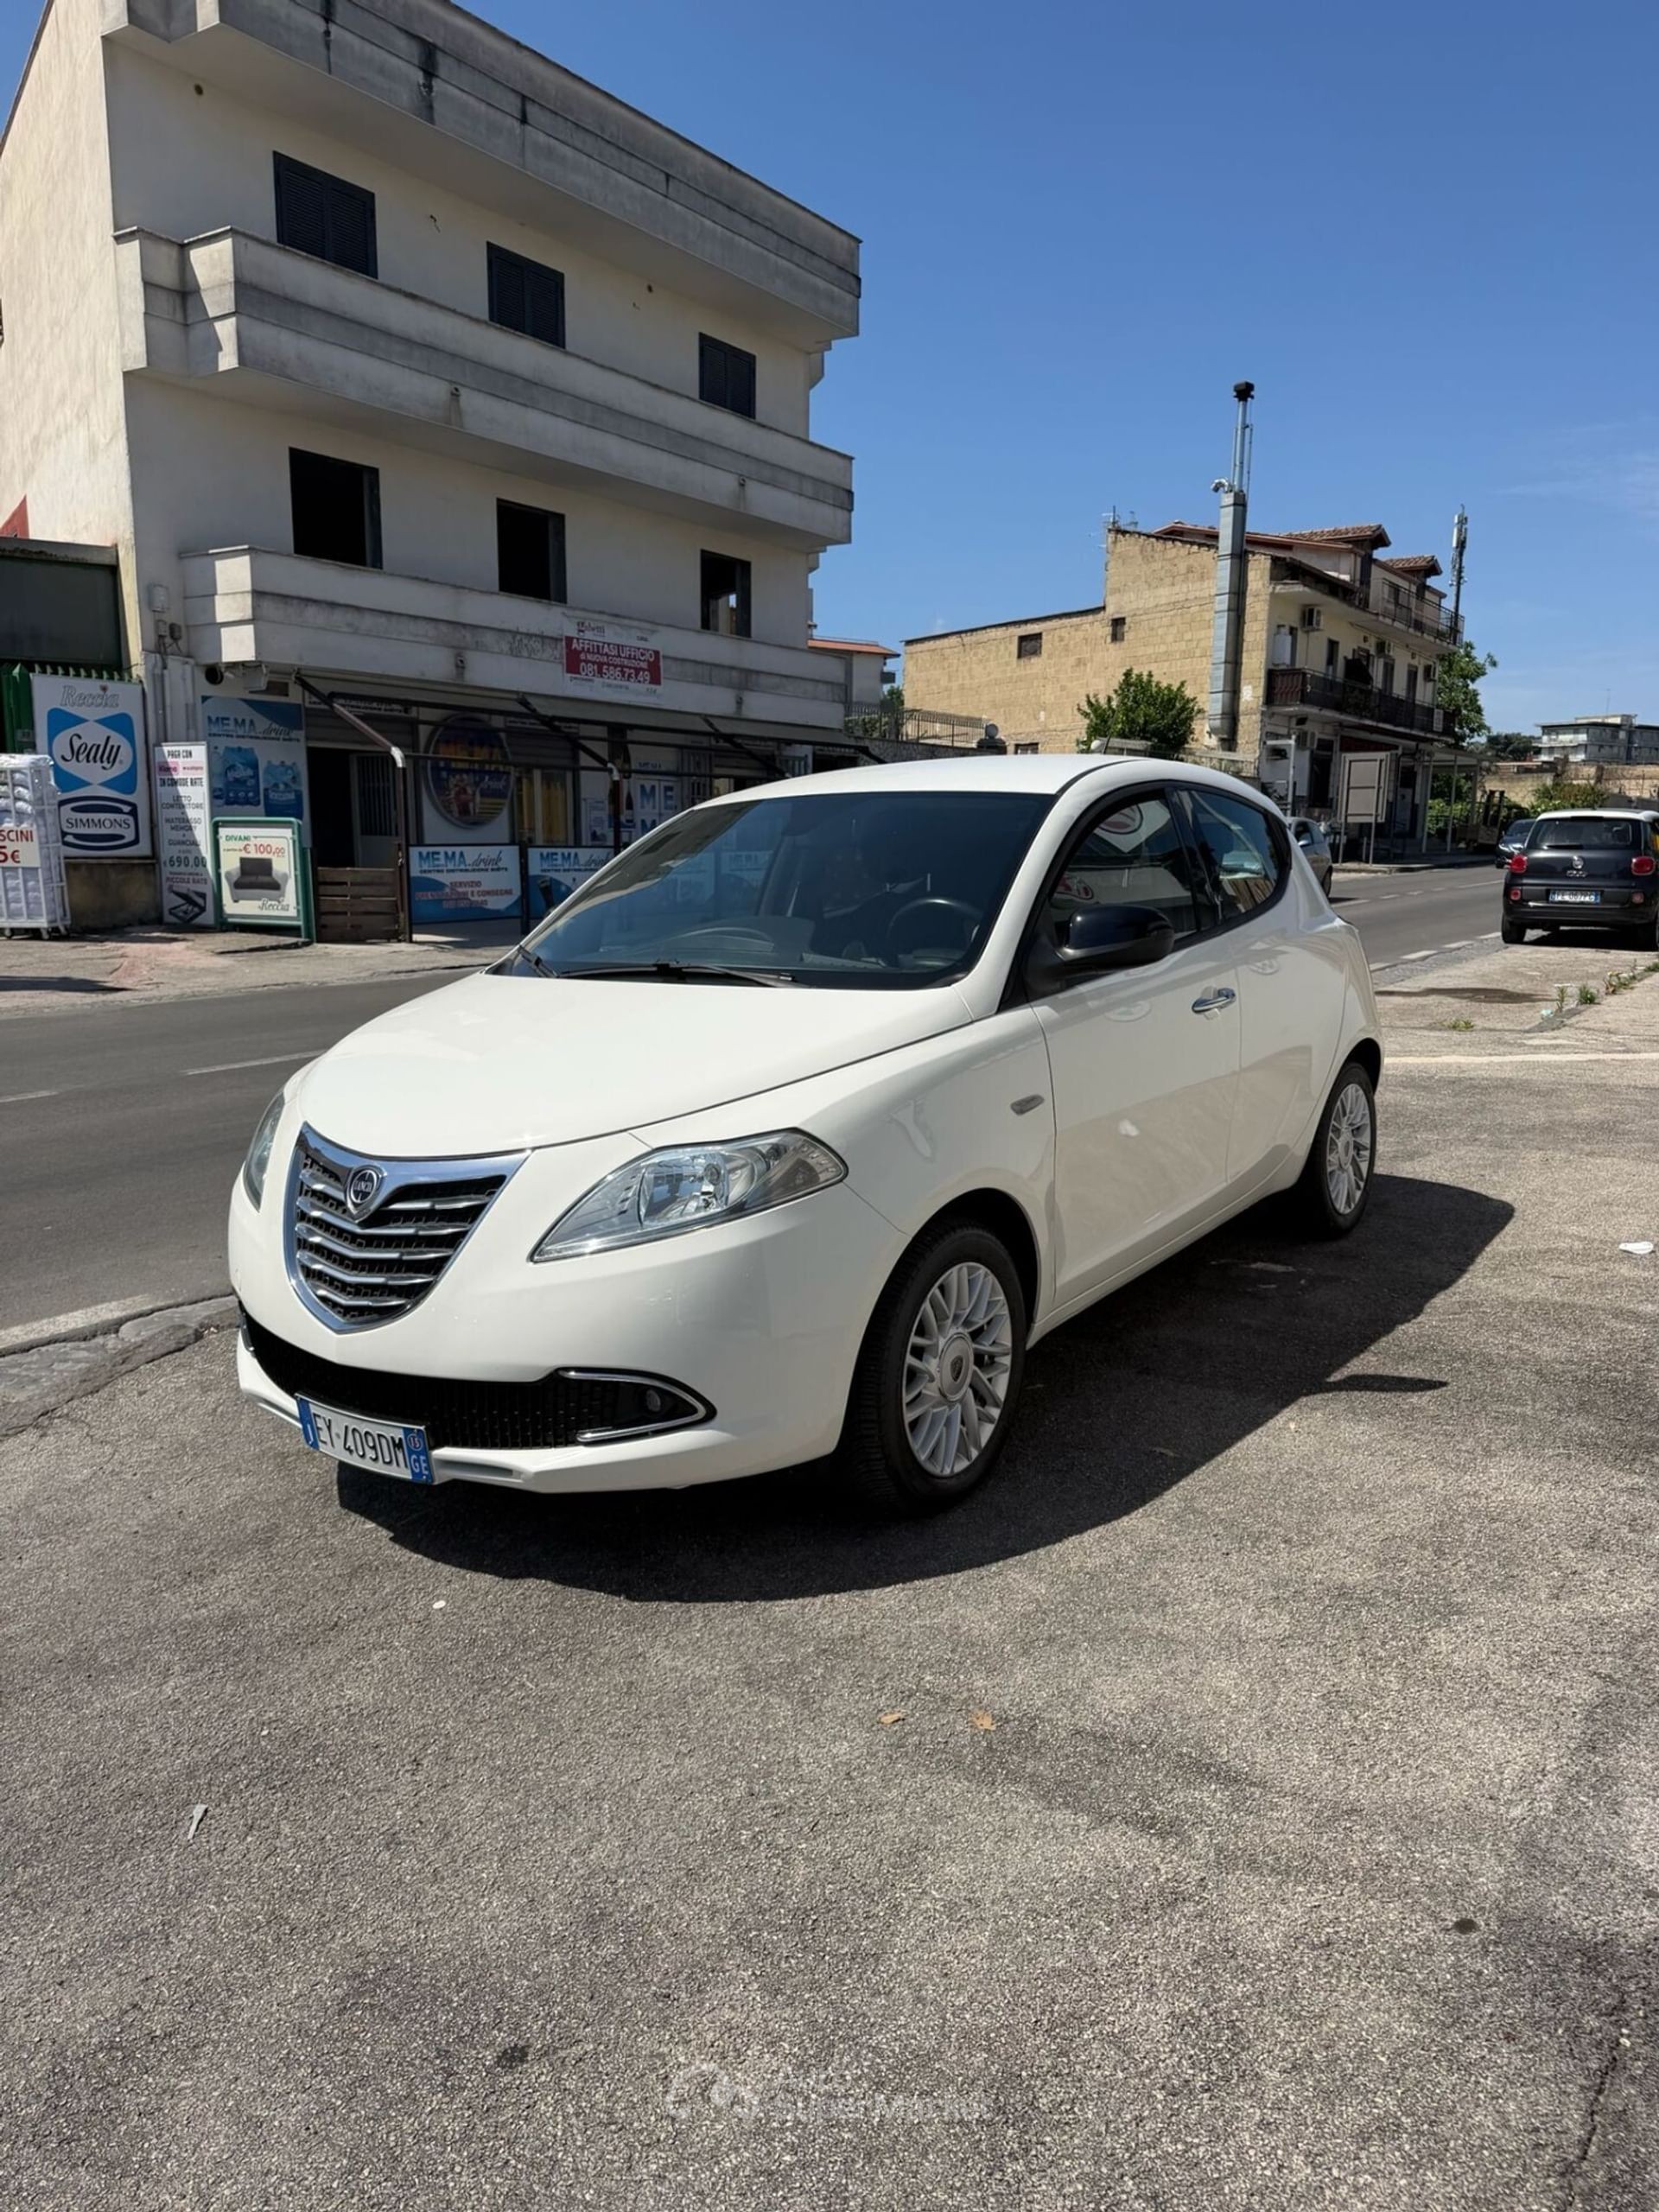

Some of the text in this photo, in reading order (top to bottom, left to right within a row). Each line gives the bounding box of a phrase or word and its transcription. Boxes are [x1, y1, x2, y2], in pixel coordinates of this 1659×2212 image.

[571, 639, 655, 662] AFFITTASI UFFICIO
[60, 684, 119, 708] Reccia
[61, 734, 122, 770] Sealy
[66, 817, 130, 830] SIMMONS
[243, 843, 251, 854] €
[168, 855, 207, 868] 690,00
[449, 880, 482, 888] SERVIZIO
[312, 1413, 334, 1448] EY
[344, 1425, 408, 1469] 409DM
[410, 1455, 429, 1476] GE
